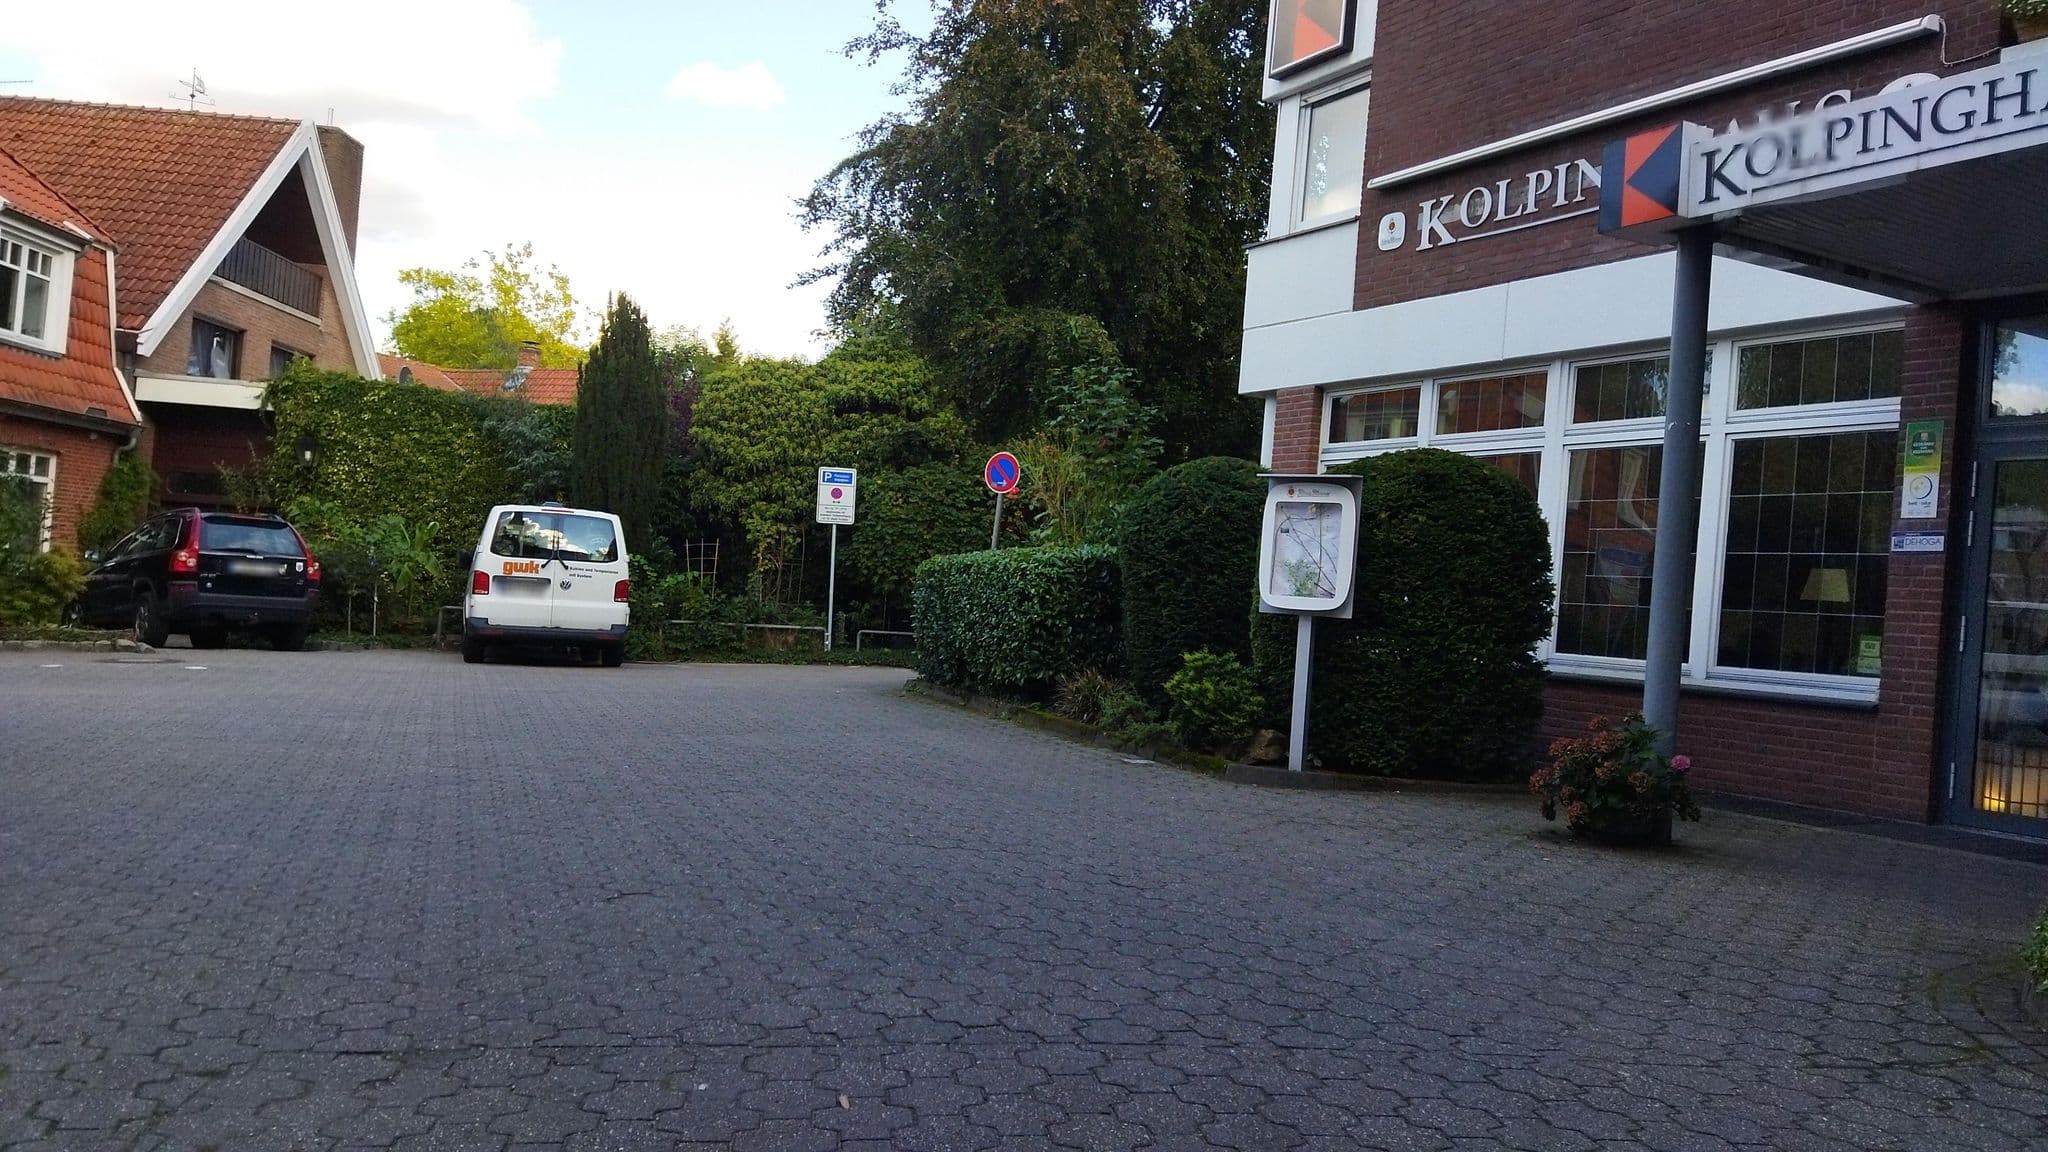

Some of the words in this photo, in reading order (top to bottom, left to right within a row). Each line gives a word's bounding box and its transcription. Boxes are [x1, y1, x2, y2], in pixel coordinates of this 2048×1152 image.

[1698, 69, 2048, 205] KOLPINGH
[1416, 158, 1602, 252] KOLPIN
[503, 560, 540, 575] gwk
[1905, 537, 1942, 546] DEHOGA
